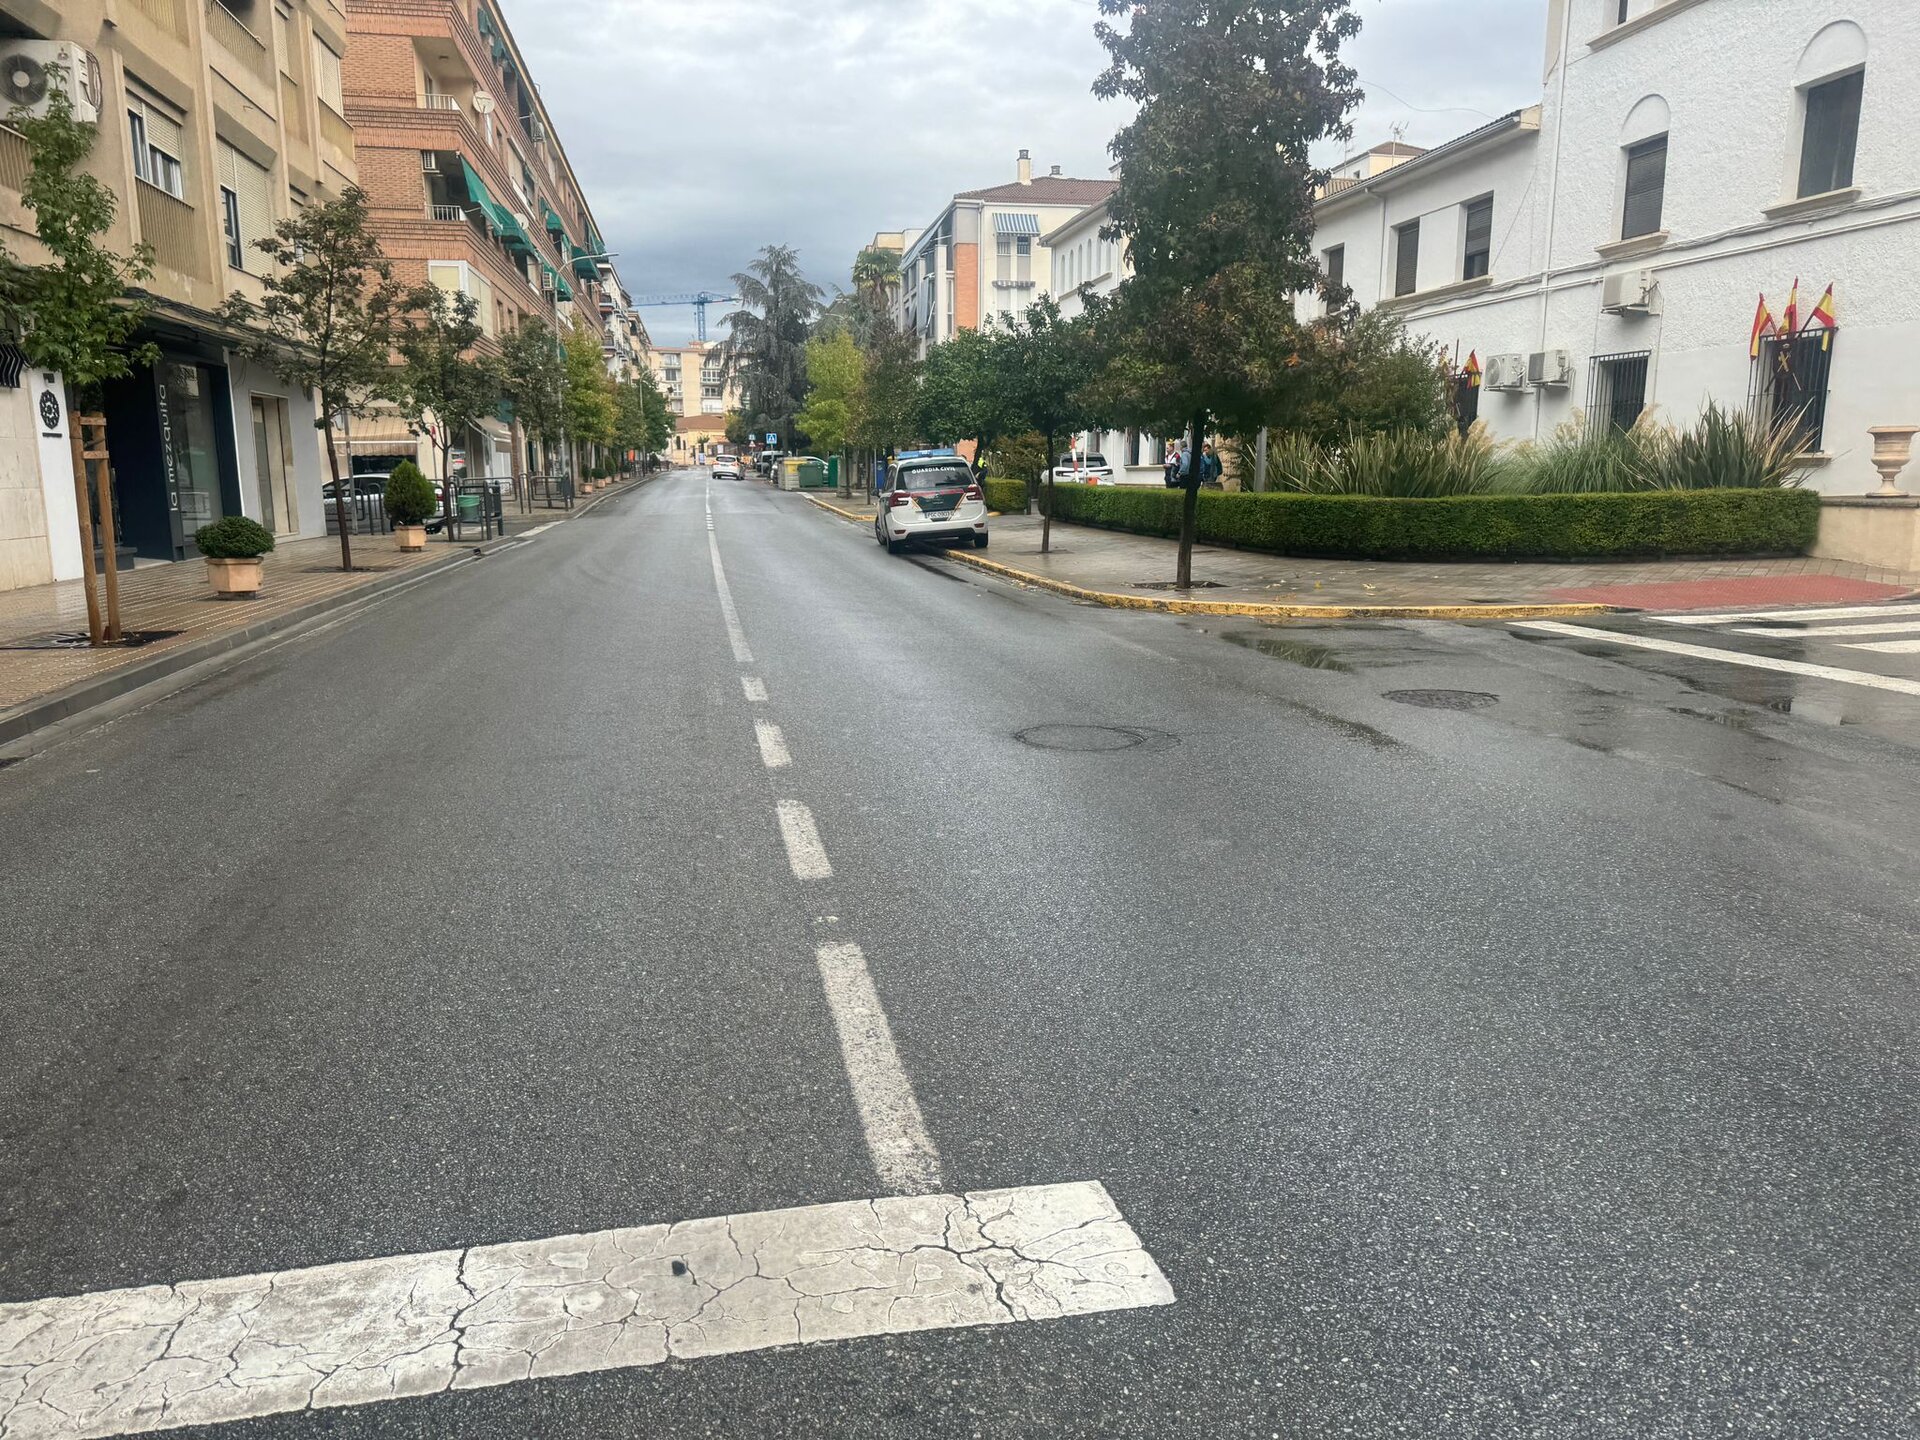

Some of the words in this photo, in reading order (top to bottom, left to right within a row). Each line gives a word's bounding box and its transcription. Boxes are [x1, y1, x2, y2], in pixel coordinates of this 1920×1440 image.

[160, 384, 175, 483] mezquita
[911, 467, 940, 475] GUARDIA
[170, 491, 178, 511] la
